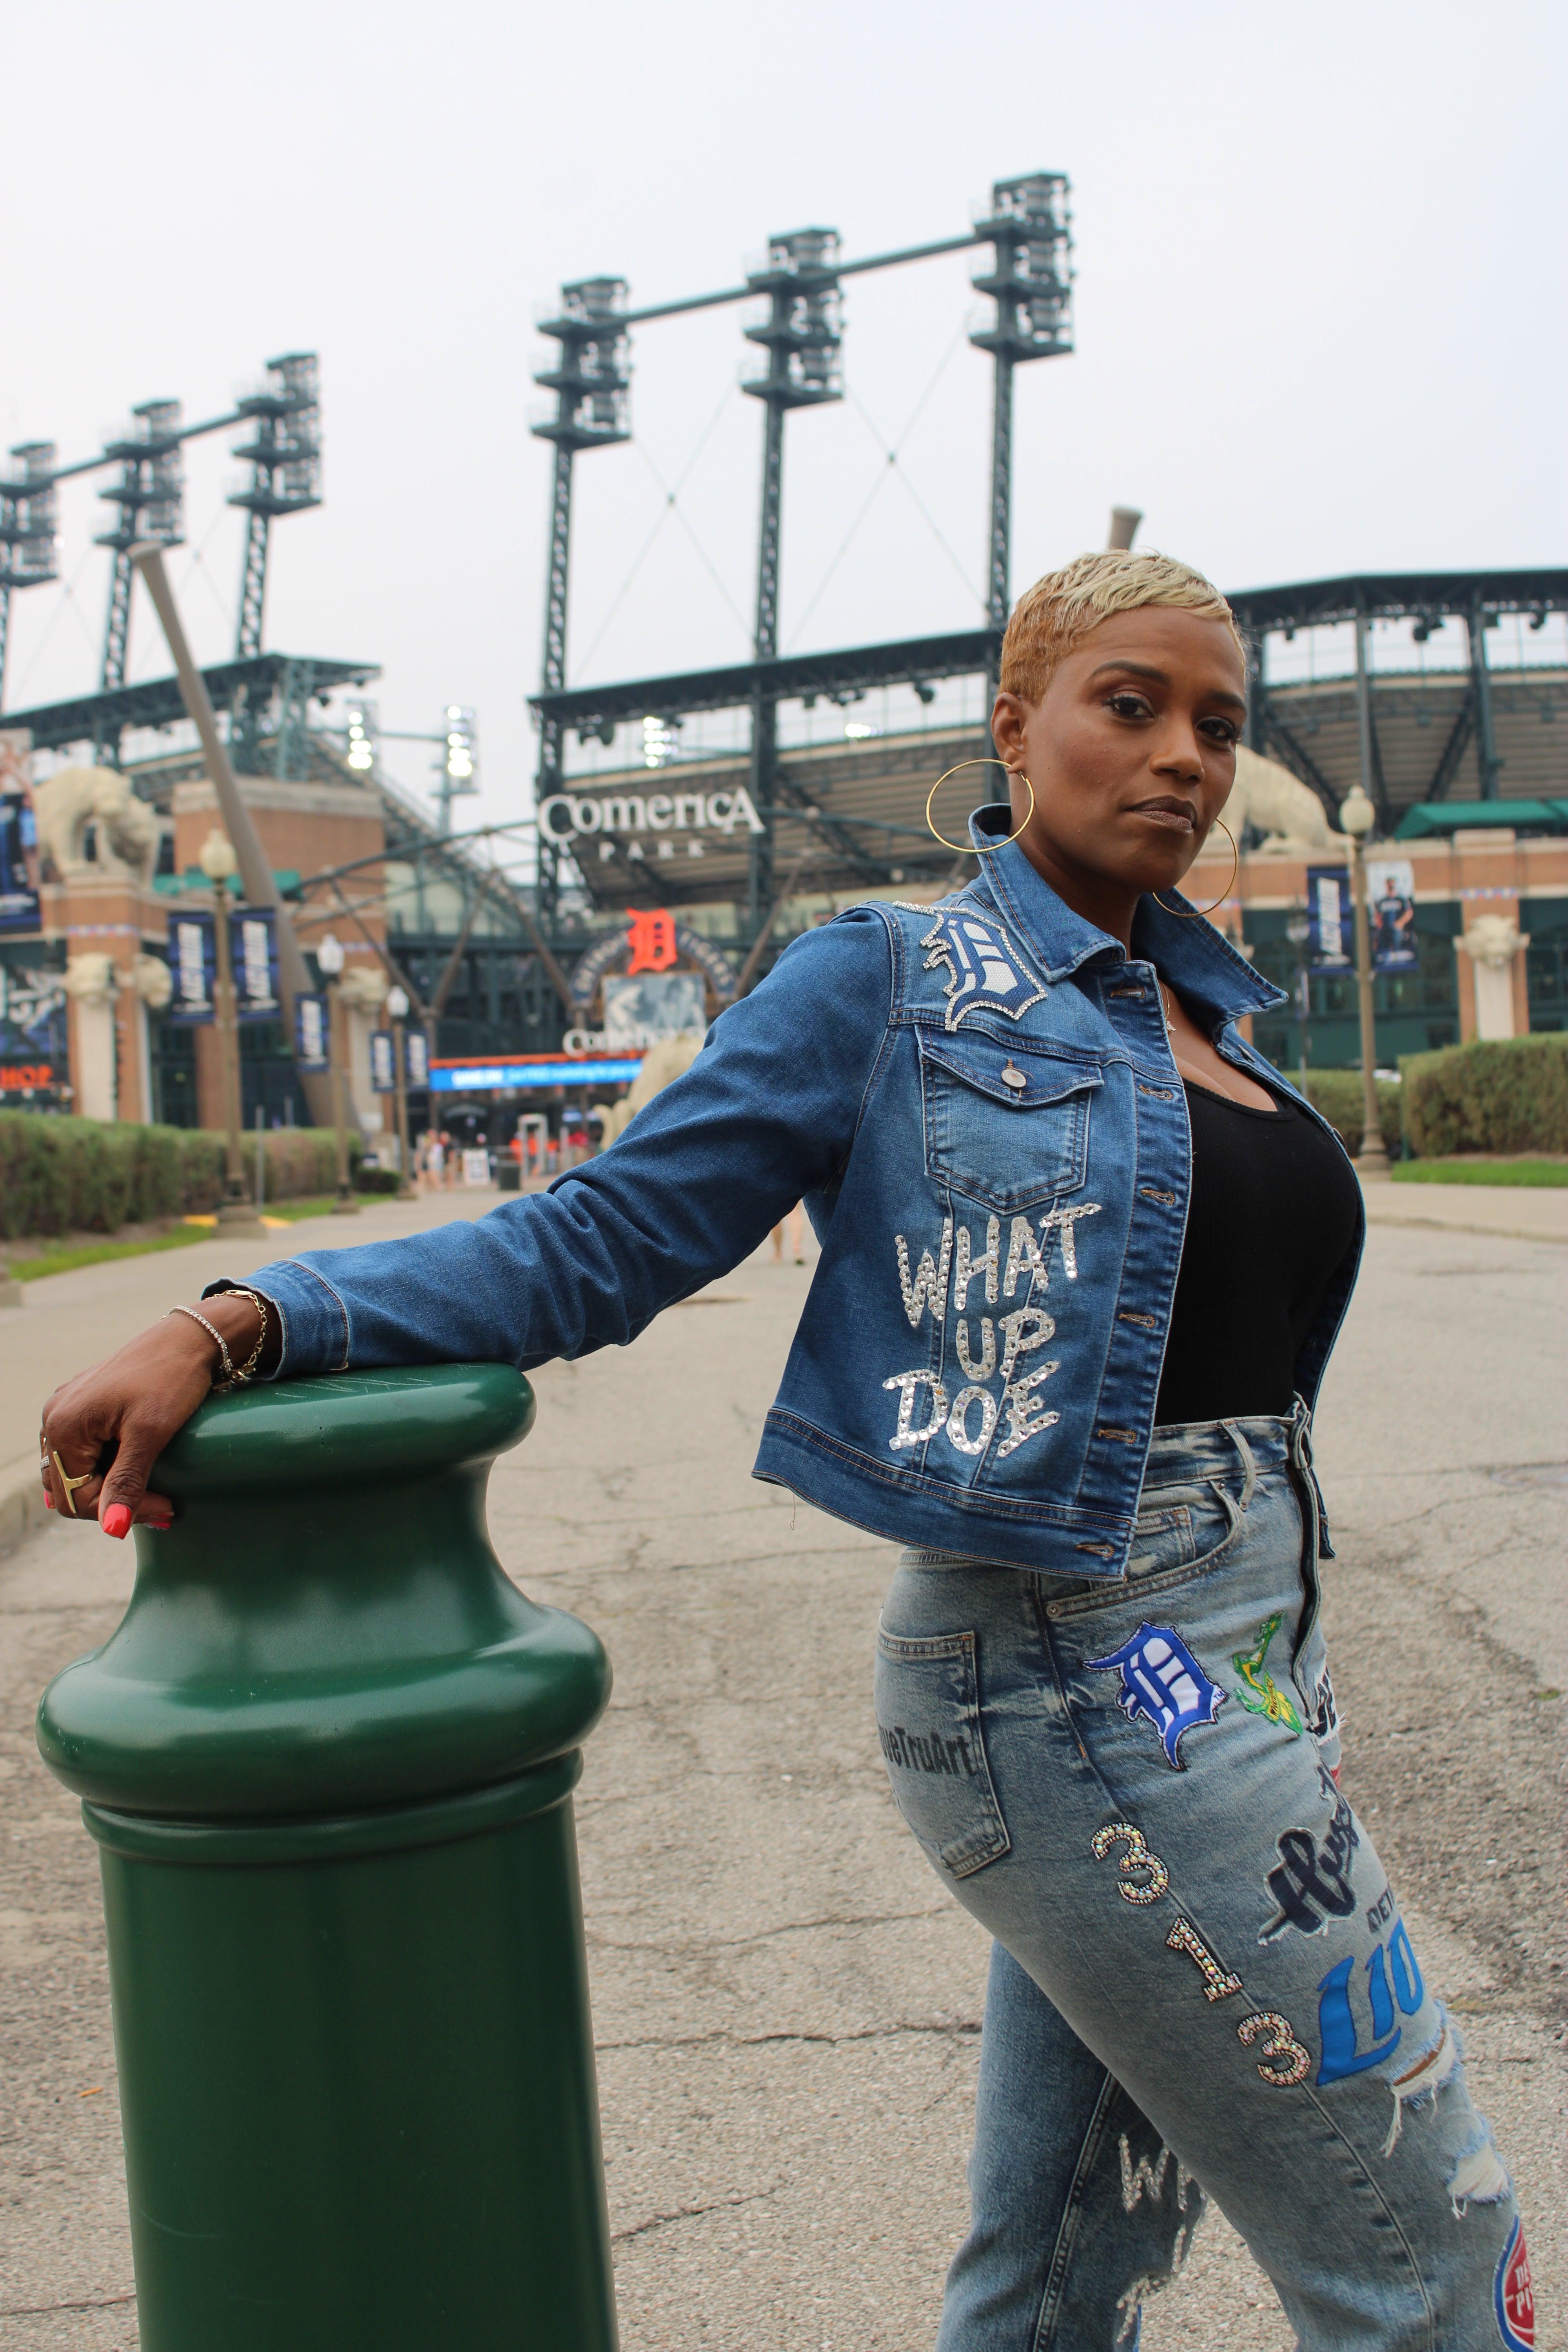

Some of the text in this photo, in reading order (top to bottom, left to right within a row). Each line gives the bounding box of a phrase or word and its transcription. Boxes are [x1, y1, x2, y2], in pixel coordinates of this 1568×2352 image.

[599, 839, 705, 861] PARK
[626, 907, 678, 977] D
[894, 1203, 1102, 1327] WHAT
[956, 1307, 1056, 1381] UP
[882, 1361, 1060, 1457] DOE
